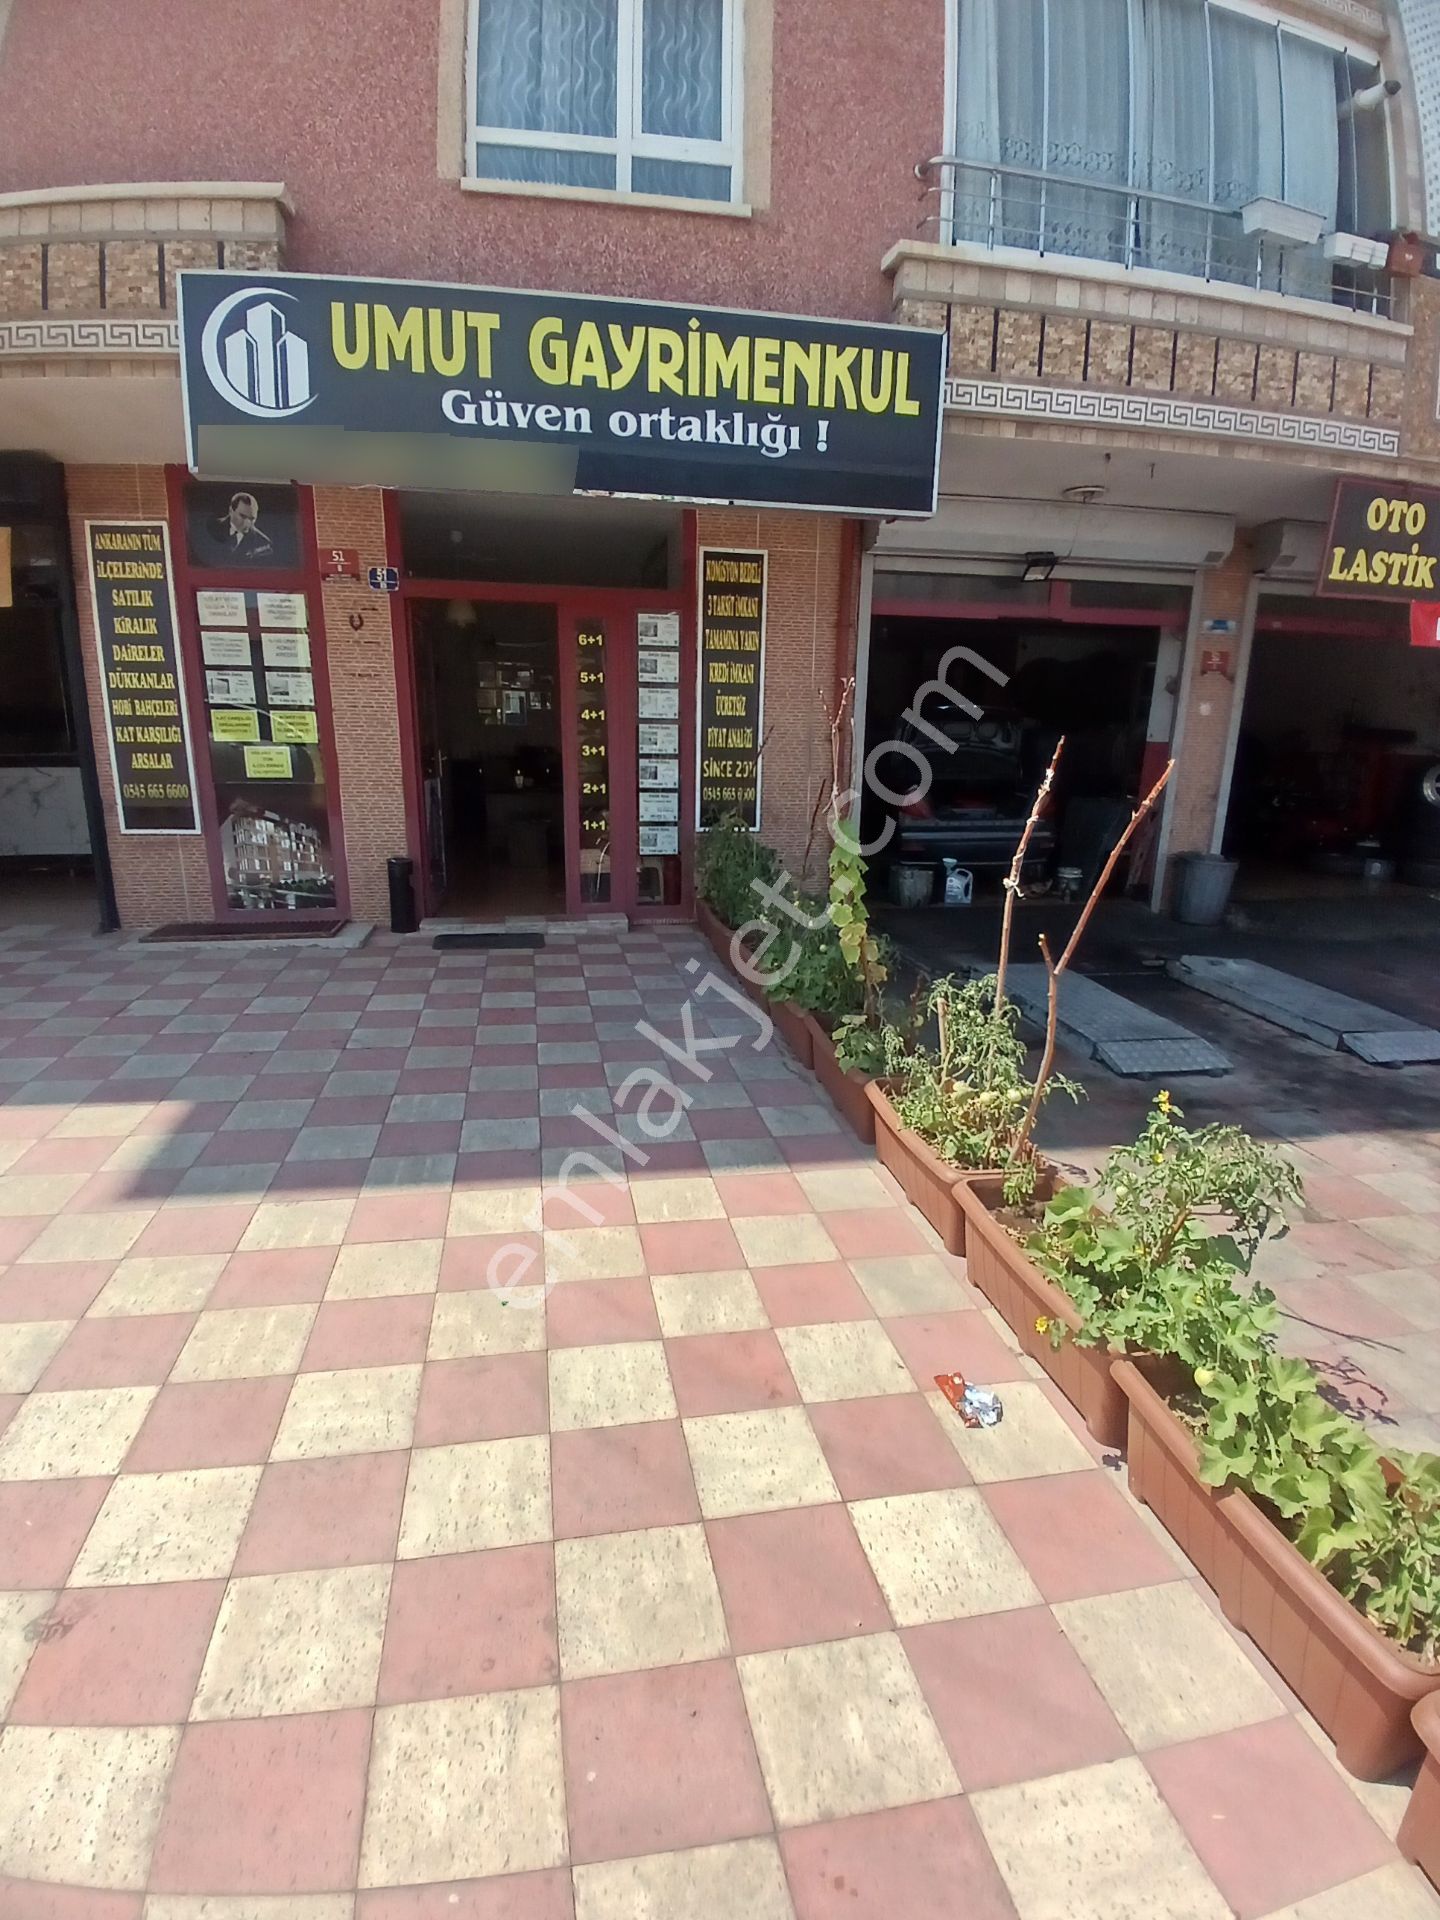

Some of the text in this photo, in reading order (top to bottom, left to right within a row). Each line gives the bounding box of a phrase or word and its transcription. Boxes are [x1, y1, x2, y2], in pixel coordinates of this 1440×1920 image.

[330, 301, 921, 416] UMUT GAYRİMENKUL
[441, 389, 594, 436] Güven
[608, 403, 801, 458] ortaklığı
[1366, 497, 1426, 536] OTO
[95, 533, 142, 551] ANKARANIN
[332, 550, 345, 562] 51
[1328, 542, 1438, 589] LASTİK
[111, 588, 154, 607] SATILIK
[578, 634, 603, 646] 6+1
[108, 666, 176, 689] DÜKKANLAR
[580, 671, 604, 684] 5+1
[581, 709, 606, 721] 4+1
[115, 725, 182, 744] KAT KARŞILIĞI
[581, 745, 606, 757] 3+1
[131, 753, 174, 769] ARSALAR
[123, 783, 189, 799] 0545 665 6600
[583, 782, 607, 795] 2+1
[582, 820, 607, 831] 1+1
